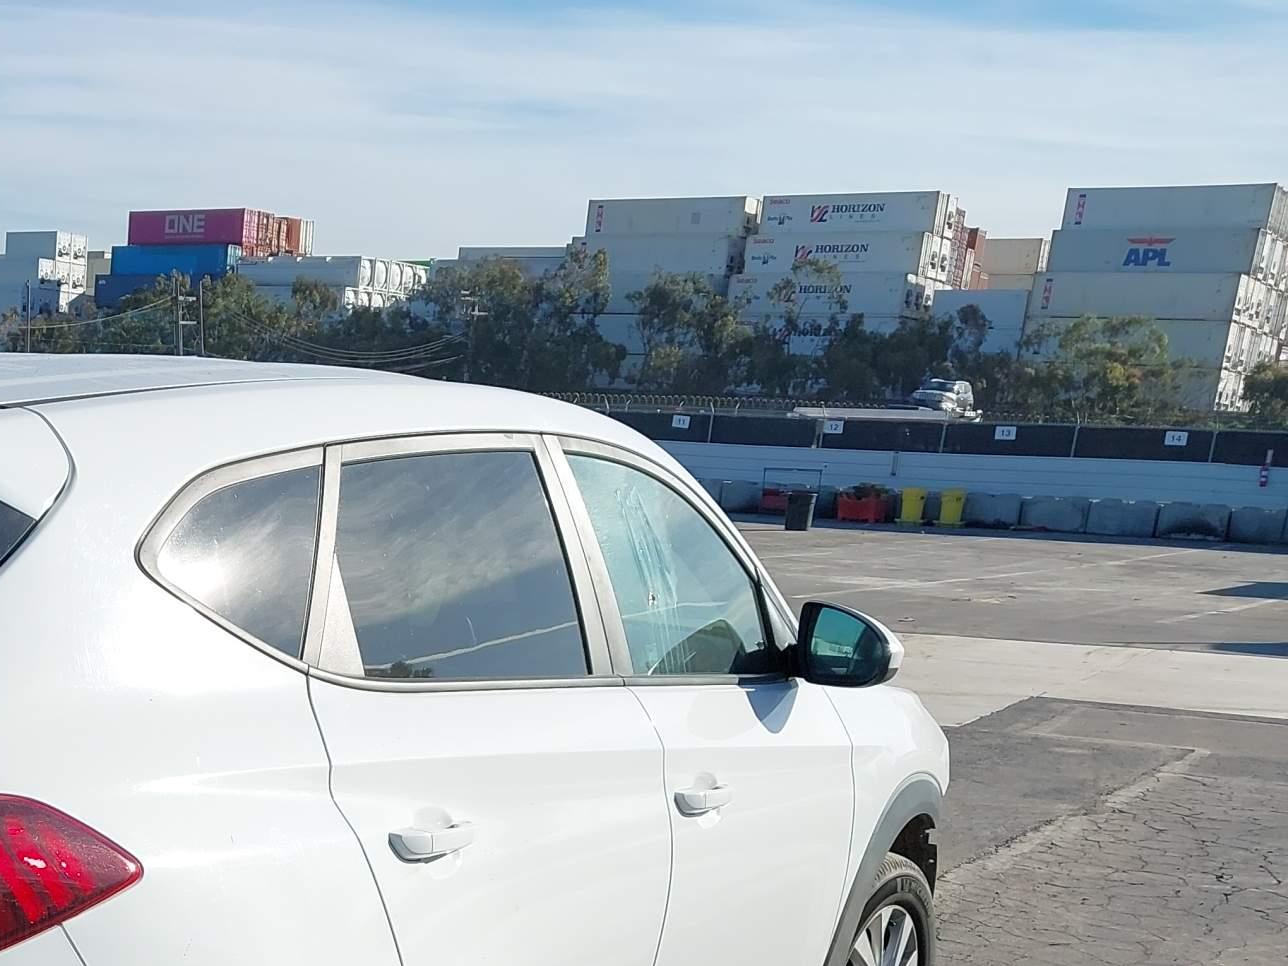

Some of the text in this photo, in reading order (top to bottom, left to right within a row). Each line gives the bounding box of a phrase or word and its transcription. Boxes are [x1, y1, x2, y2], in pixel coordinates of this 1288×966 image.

[831, 203, 886, 214] HORIZON
[164, 214, 206, 234] ONE
[814, 243, 870, 254] HORIZON
[1122, 247, 1172, 267] APL
[1001, 429, 1011, 437] 13
[1172, 435, 1182, 443] 14
